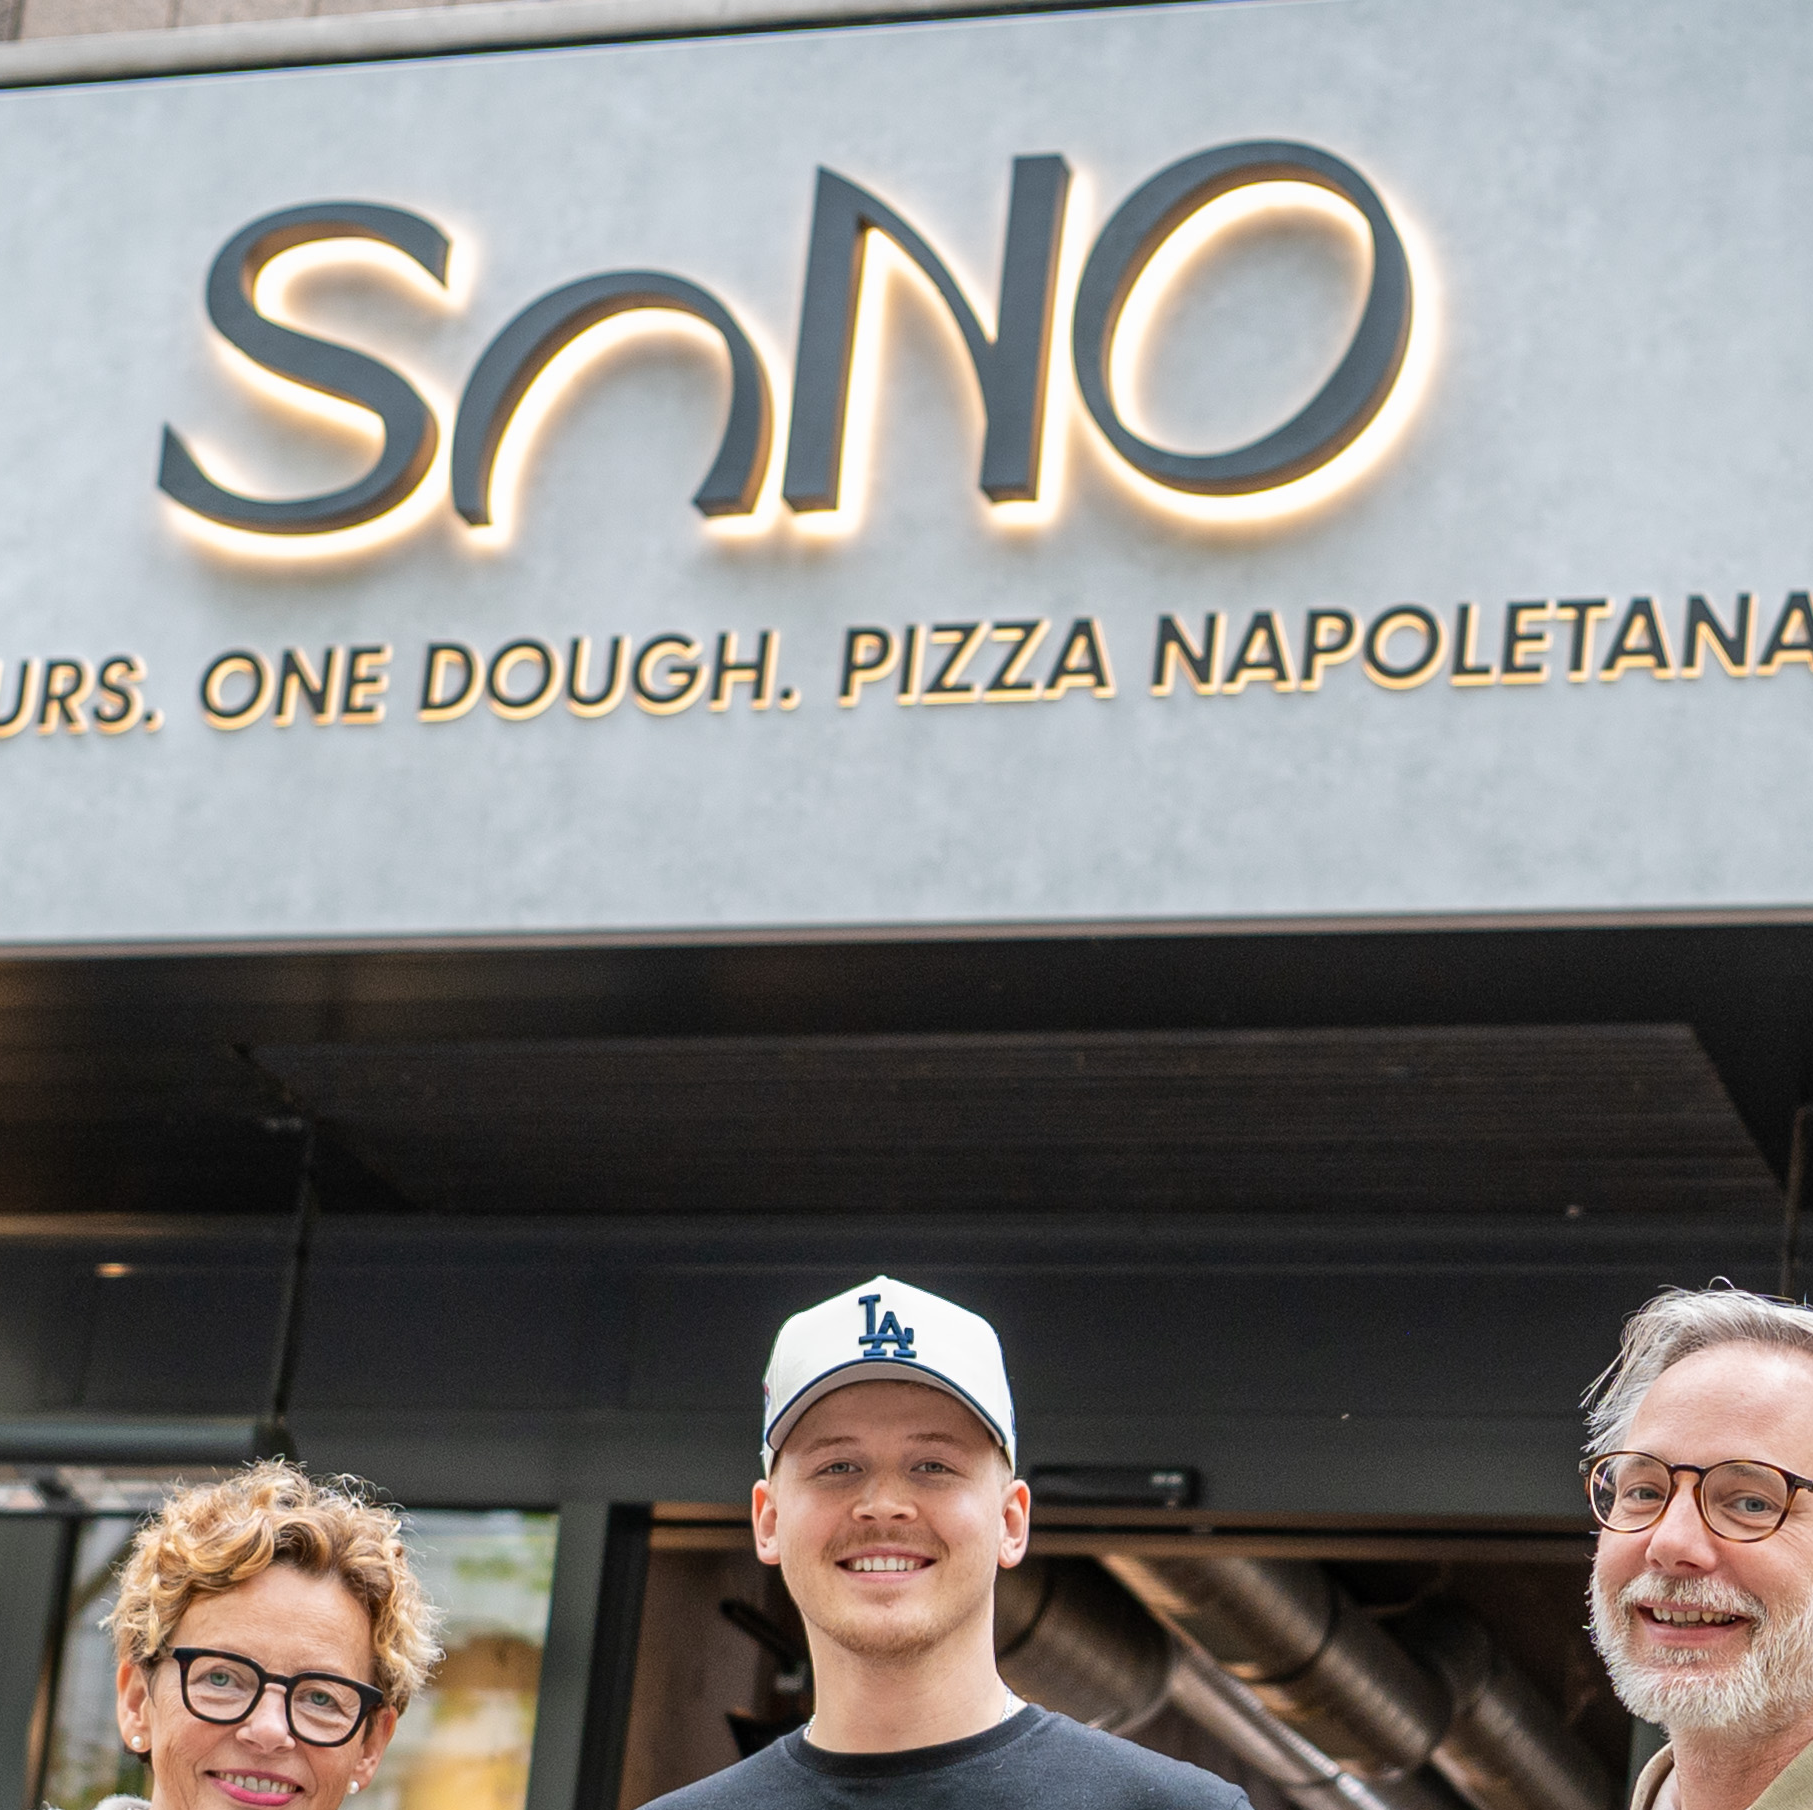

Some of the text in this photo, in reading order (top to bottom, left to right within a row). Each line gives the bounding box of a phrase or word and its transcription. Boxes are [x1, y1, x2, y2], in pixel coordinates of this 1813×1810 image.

[199, 643, 392, 730] ONE
[418, 630, 799, 723] DOUGH.
[837, 616, 1117, 707] PIZZA
[858, 1294, 917, 1359] LA
